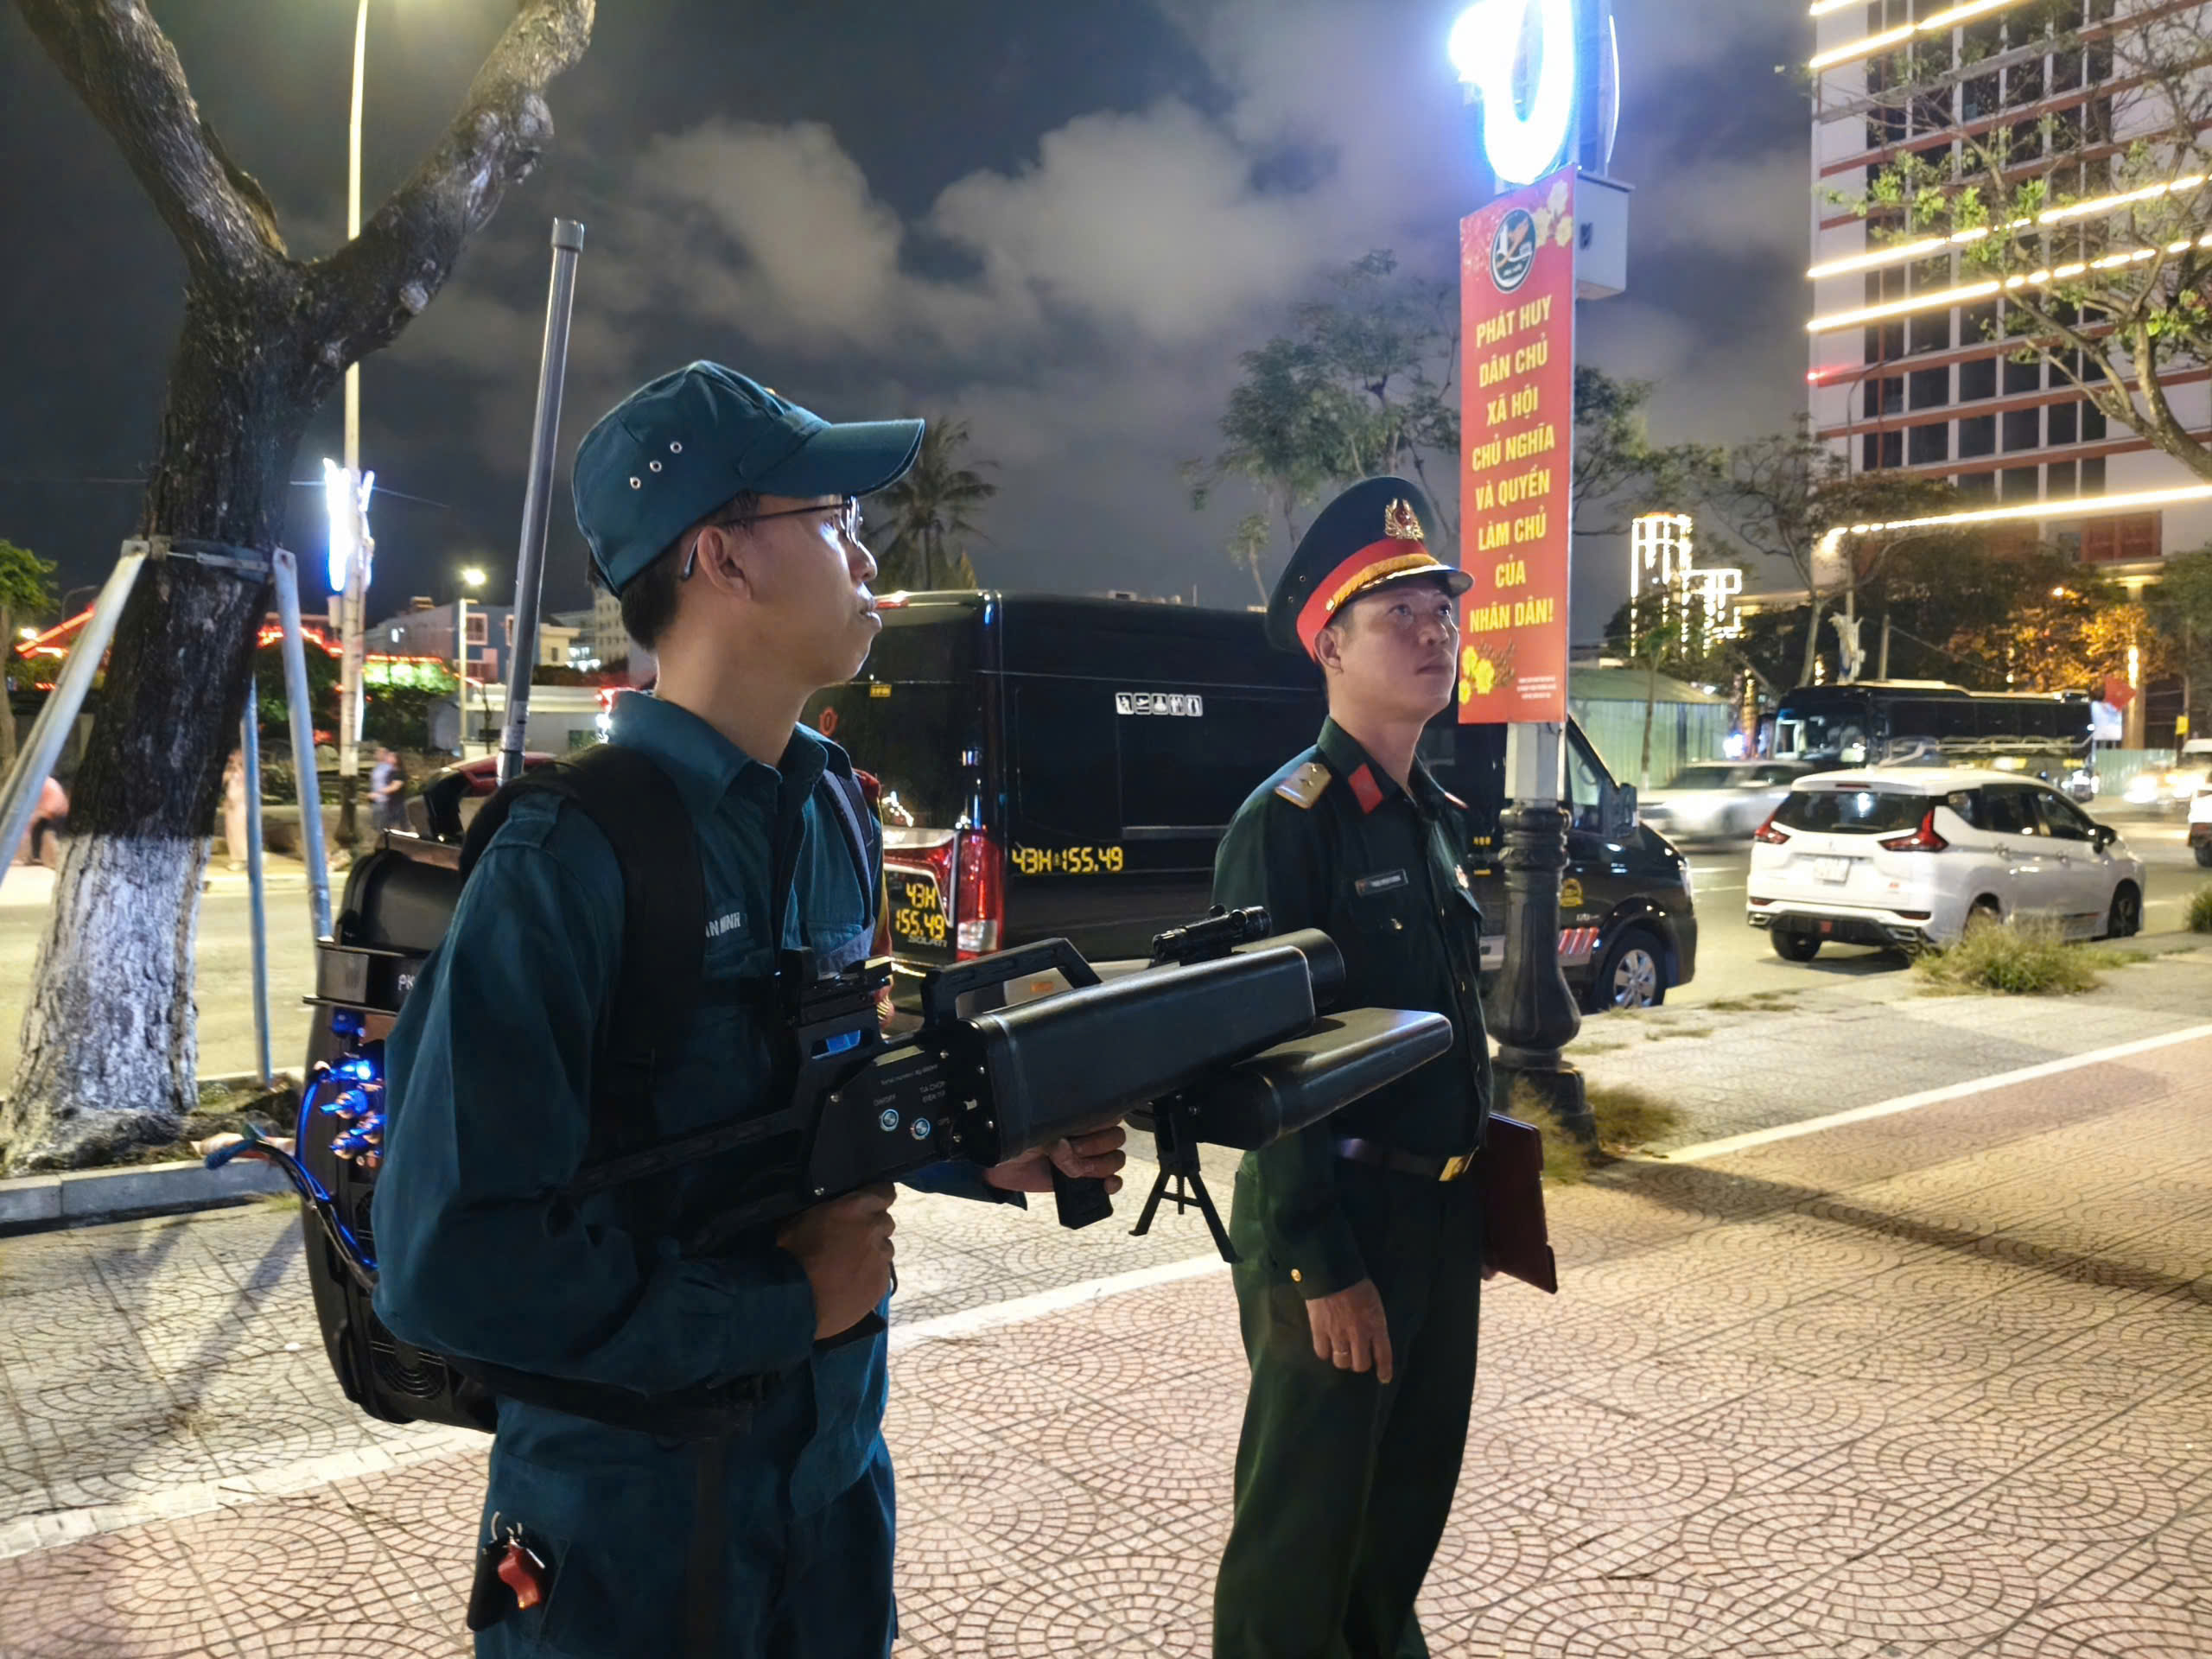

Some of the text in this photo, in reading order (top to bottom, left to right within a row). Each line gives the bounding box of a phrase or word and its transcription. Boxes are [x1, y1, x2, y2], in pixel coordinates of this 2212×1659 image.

[1476, 295, 1552, 348] PHÁT HUY
[1479, 332, 1548, 388] DÂN CHỦ
[1511, 383, 1538, 419] HỘI
[1472, 423, 1554, 472] CHỦ NGHĨA
[1475, 479, 1494, 512] VÀ
[1478, 505, 1547, 551] LÀM CHỦ
[1495, 553, 1526, 588] CỦA
[1470, 595, 1554, 633] NHÂN DÂN!
[1011, 846, 1123, 874] 43H 155.49
[906, 882, 938, 910] 43H
[895, 909, 945, 940] 155.49
